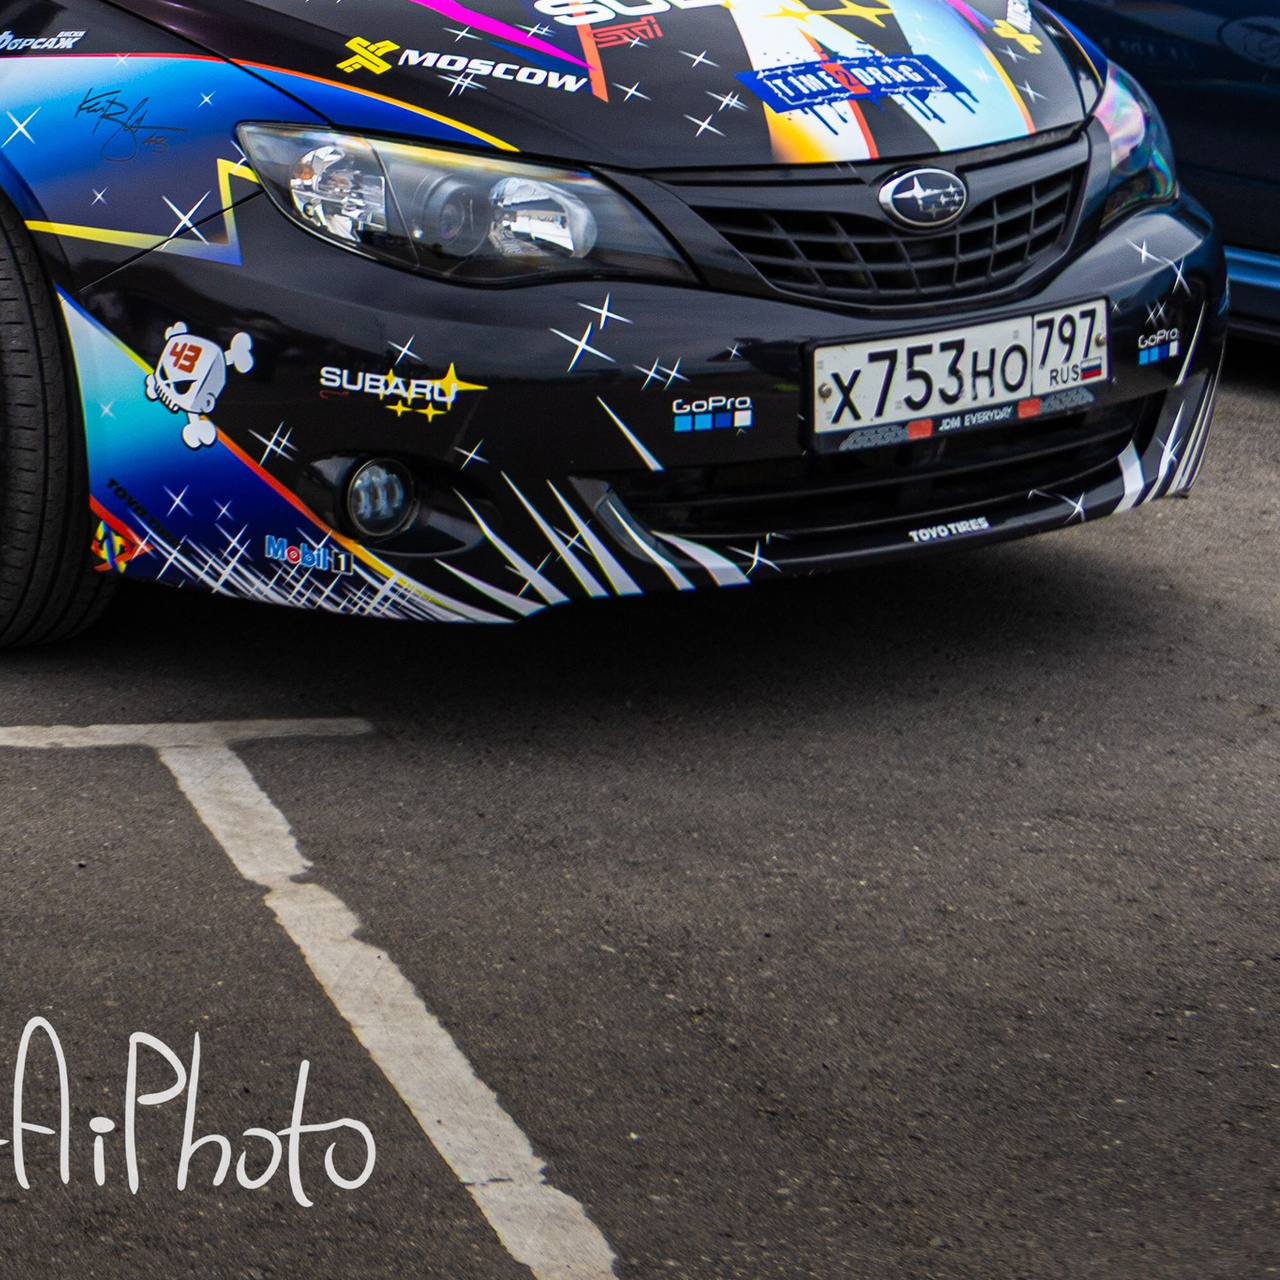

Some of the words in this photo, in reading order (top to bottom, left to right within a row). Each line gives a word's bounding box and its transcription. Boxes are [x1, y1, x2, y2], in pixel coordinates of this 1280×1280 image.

[397, 47, 589, 93] MOSCOW
[1036, 308, 1097, 370] 797
[1138, 327, 1179, 349] GoPro
[169, 341, 203, 374] 43
[320, 366, 458, 403] SUBARU
[1050, 365, 1080, 387] RUS
[672, 395, 753, 414] GoPro
[938, 415, 962, 431] JDM
[908, 524, 949, 543] TOYO
[947, 516, 990, 536] TIRES
[265, 534, 329, 571] Mobil
